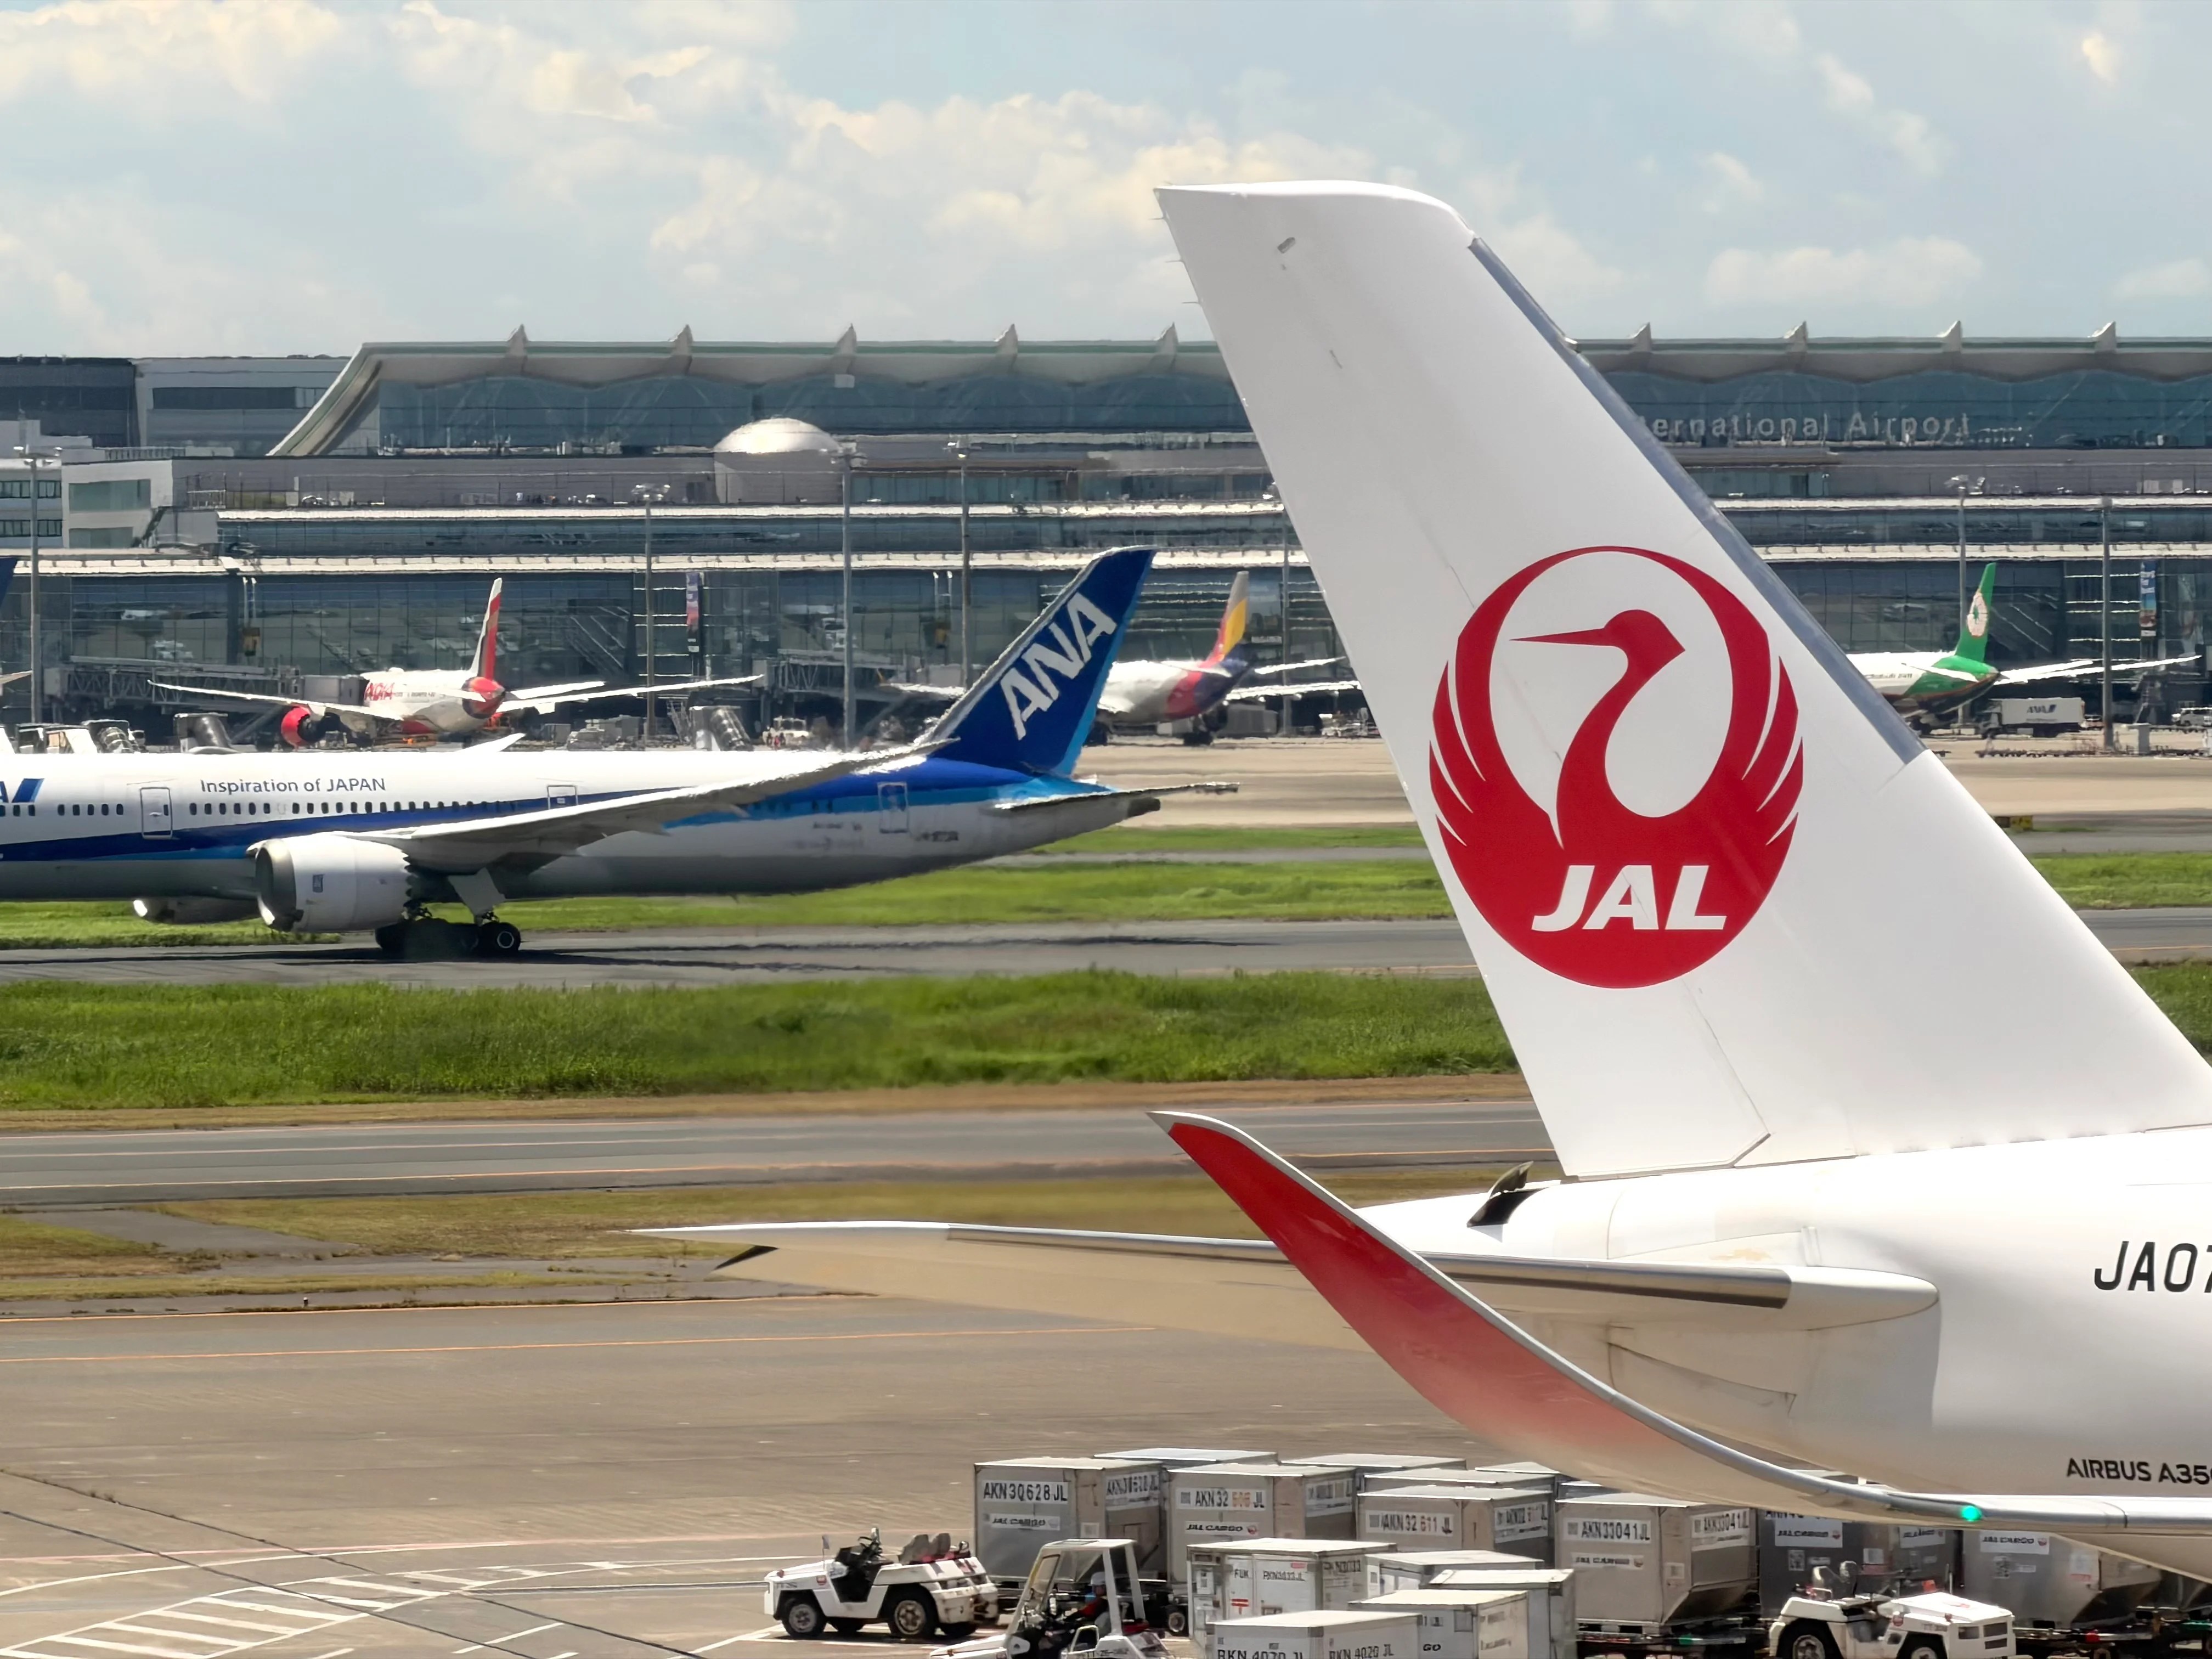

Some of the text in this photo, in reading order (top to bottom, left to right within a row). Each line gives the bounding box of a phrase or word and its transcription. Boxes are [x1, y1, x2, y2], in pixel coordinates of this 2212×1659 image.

[1845, 411, 1970, 441] Airport
[1000, 592, 1118, 741] ANA
[200, 778, 387, 795] Inspiration of JAPAN
[1531, 865, 1727, 932] JAL
[2094, 1240, 2212, 1293] JA0
[2066, 1457, 2212, 1485] AIRBUS A35
